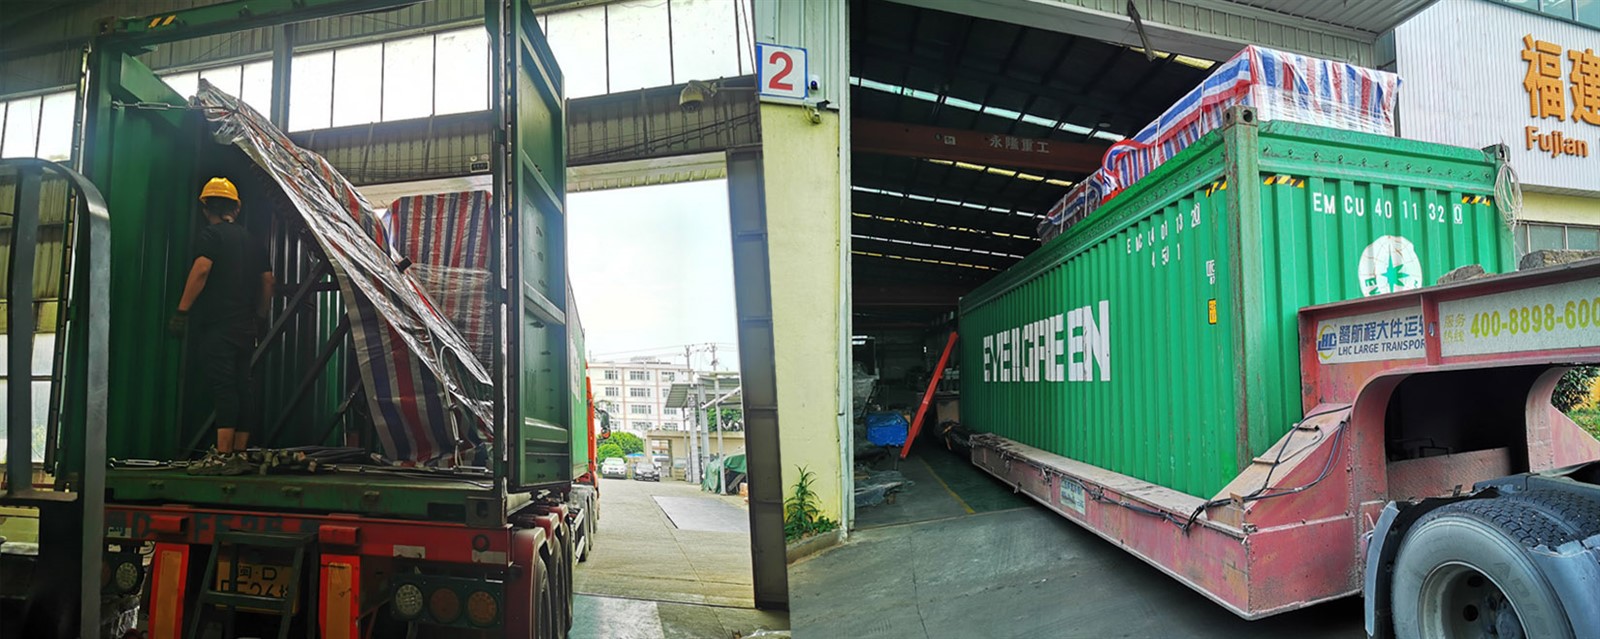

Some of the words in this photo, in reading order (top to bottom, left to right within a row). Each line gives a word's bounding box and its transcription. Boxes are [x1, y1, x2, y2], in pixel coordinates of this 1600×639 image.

[768, 51, 794, 91] 2
[1521, 33, 1600, 126] 福建
[1525, 125, 1588, 158] Fujian
[1338, 346, 1352, 356] LHC
[1354, 343, 1379, 354] LARGE
